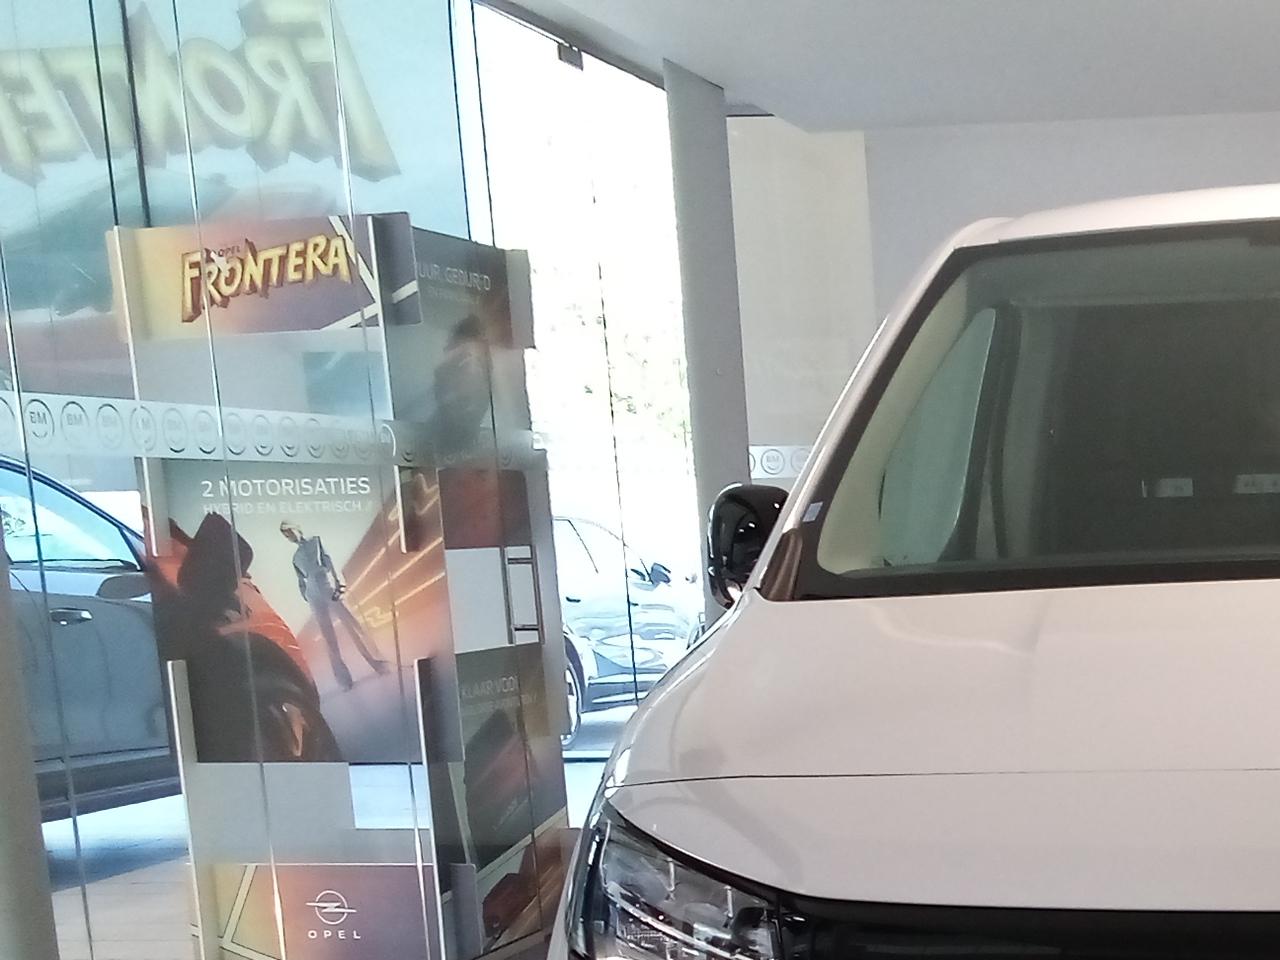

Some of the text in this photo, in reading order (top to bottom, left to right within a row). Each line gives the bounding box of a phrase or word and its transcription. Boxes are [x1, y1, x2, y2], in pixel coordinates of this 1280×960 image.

[181, 233, 353, 323] FRONTERA
[200, 476, 371, 498] 2 MOTORISATIES
[259, 502, 276, 514] EN
[280, 500, 362, 514] ELEKTRISCH
[307, 929, 361, 940] OPEL
